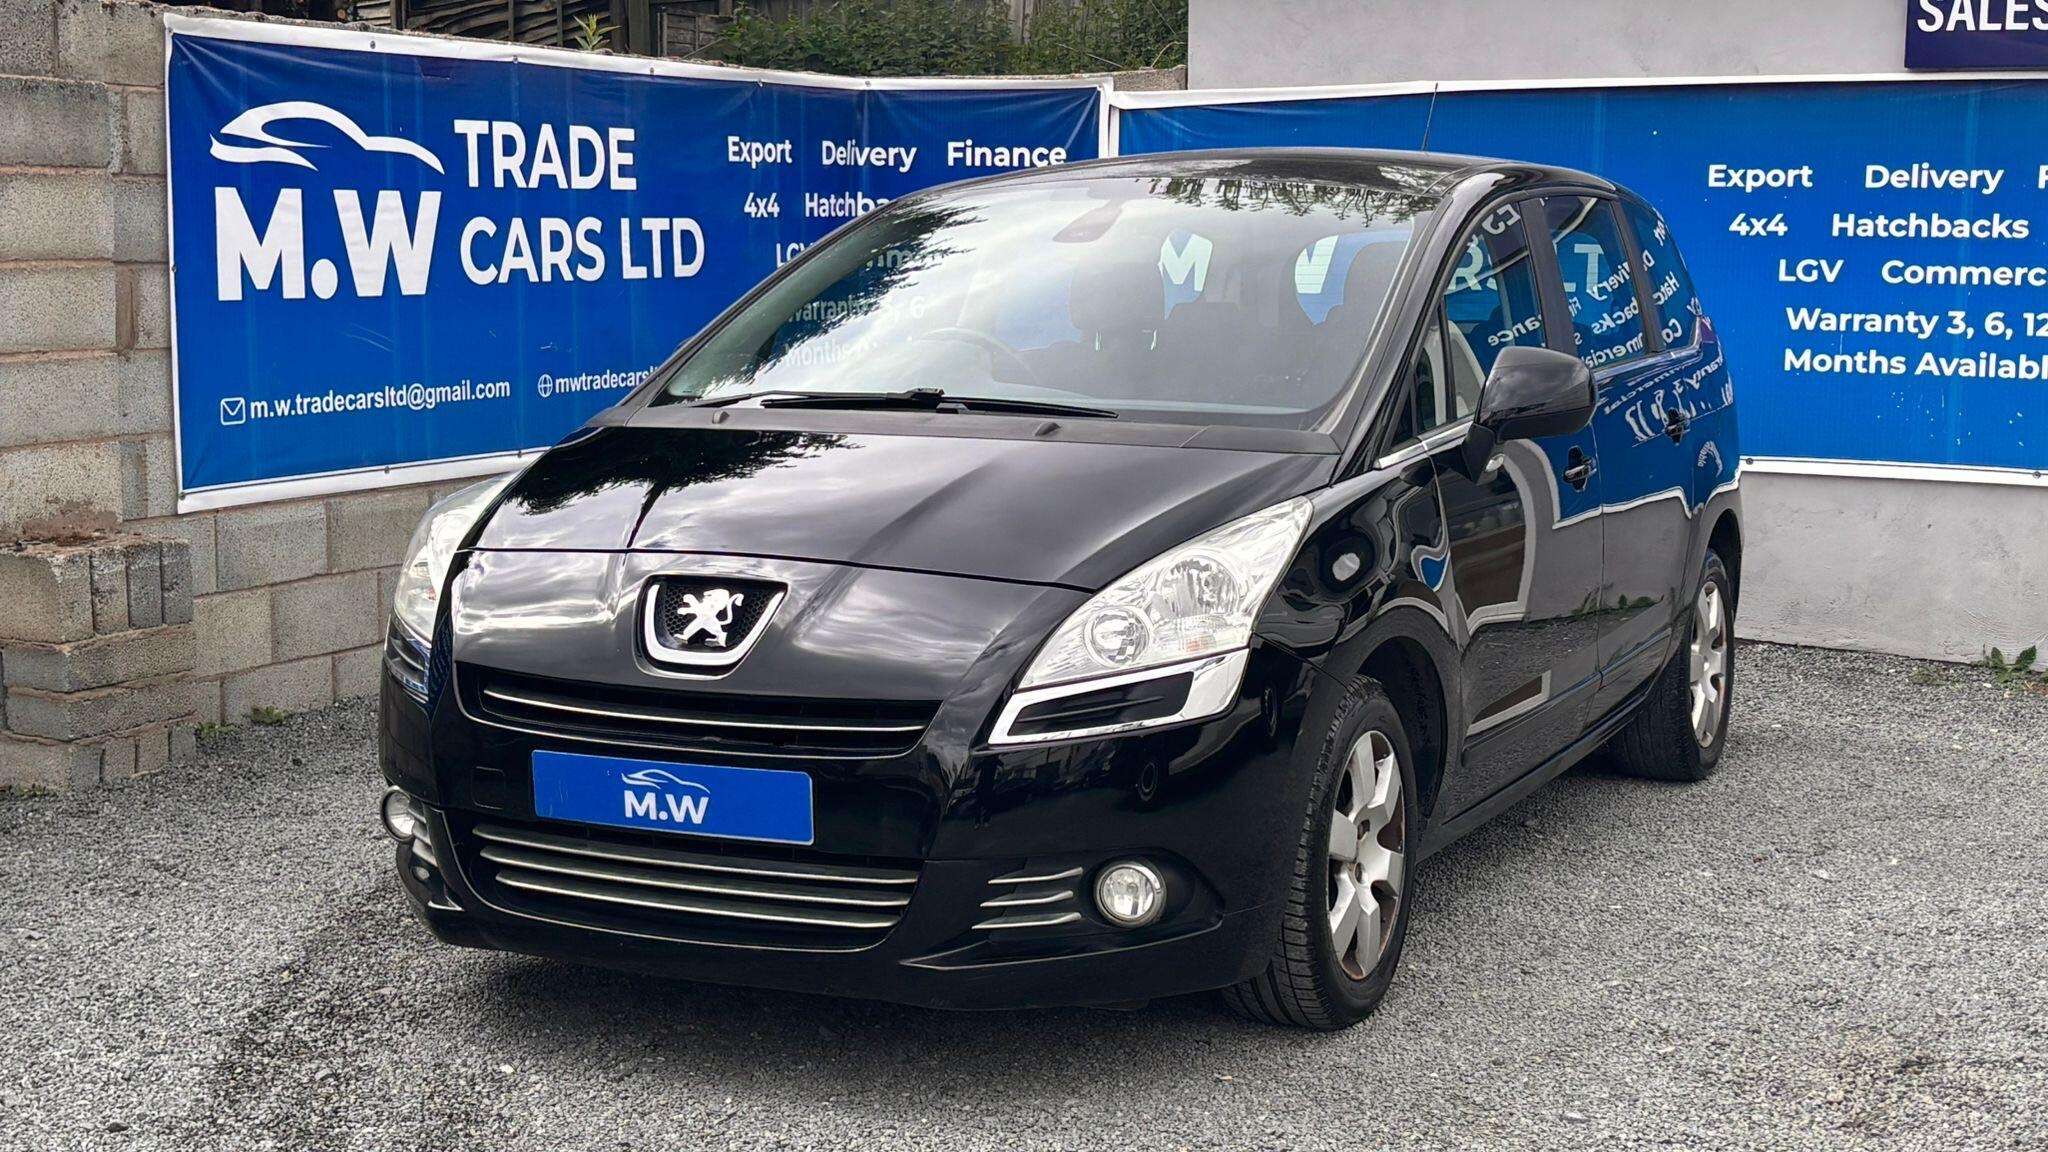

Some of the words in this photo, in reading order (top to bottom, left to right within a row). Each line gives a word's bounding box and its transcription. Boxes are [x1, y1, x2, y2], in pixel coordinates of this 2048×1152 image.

[453, 119, 636, 190] TRADE
[727, 135, 792, 168] Export
[822, 138, 916, 172] Delivery
[947, 138, 1066, 167] Finance
[1708, 164, 1812, 192] Export
[1865, 162, 2004, 194] Delivery
[743, 192, 779, 217] 4x4
[1728, 213, 1787, 235] 4x4
[1832, 212, 2029, 238] Hatchbacks
[214, 186, 441, 300] M.W
[460, 216, 605, 284] CARS
[620, 217, 704, 279] LTD
[1778, 258, 1843, 282] LGV
[1881, 259, 2046, 286] Commerc
[1786, 307, 1939, 339] Warranty
[1946, 310, 1974, 339] 3,
[1984, 311, 2012, 339] 6,
[1784, 348, 1906, 374] Months
[1914, 351, 2048, 379] Availabl
[250, 379, 510, 418] m.w.tradecarsltd@gmail.com
[624, 790, 708, 823] M.W
